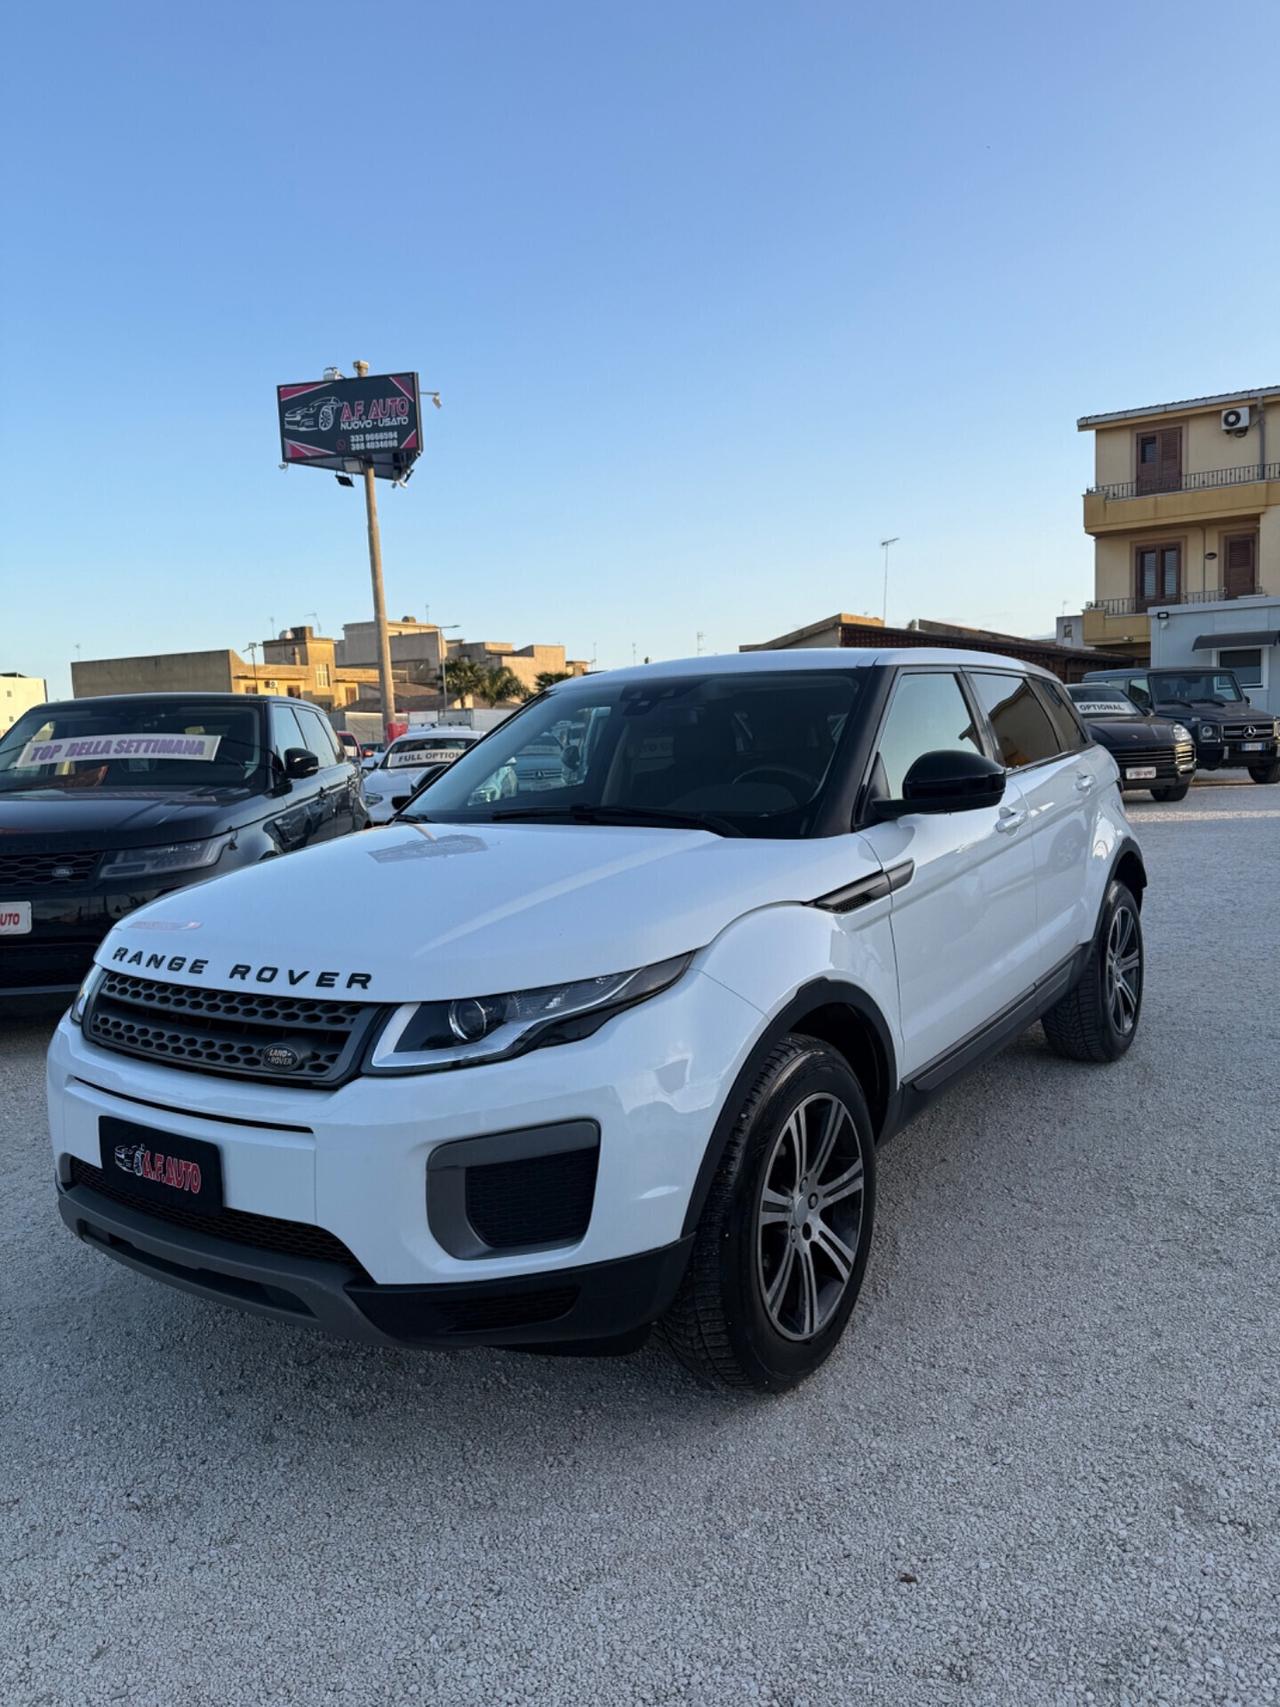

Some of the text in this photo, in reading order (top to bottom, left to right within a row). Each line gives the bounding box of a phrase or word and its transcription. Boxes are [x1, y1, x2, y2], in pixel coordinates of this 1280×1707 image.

[368, 397, 409, 419] AUTO
[340, 417, 408, 430] NUOVO USATO
[31, 739, 205, 761] TOP DELLA SETTIMANA
[398, 753, 422, 762] FULL
[0, 913, 20, 926] UTO
[112, 947, 373, 989] RANGE ROVER
[269, 1049, 288, 1057] LAND
[271, 1057, 292, 1065] ROVER
